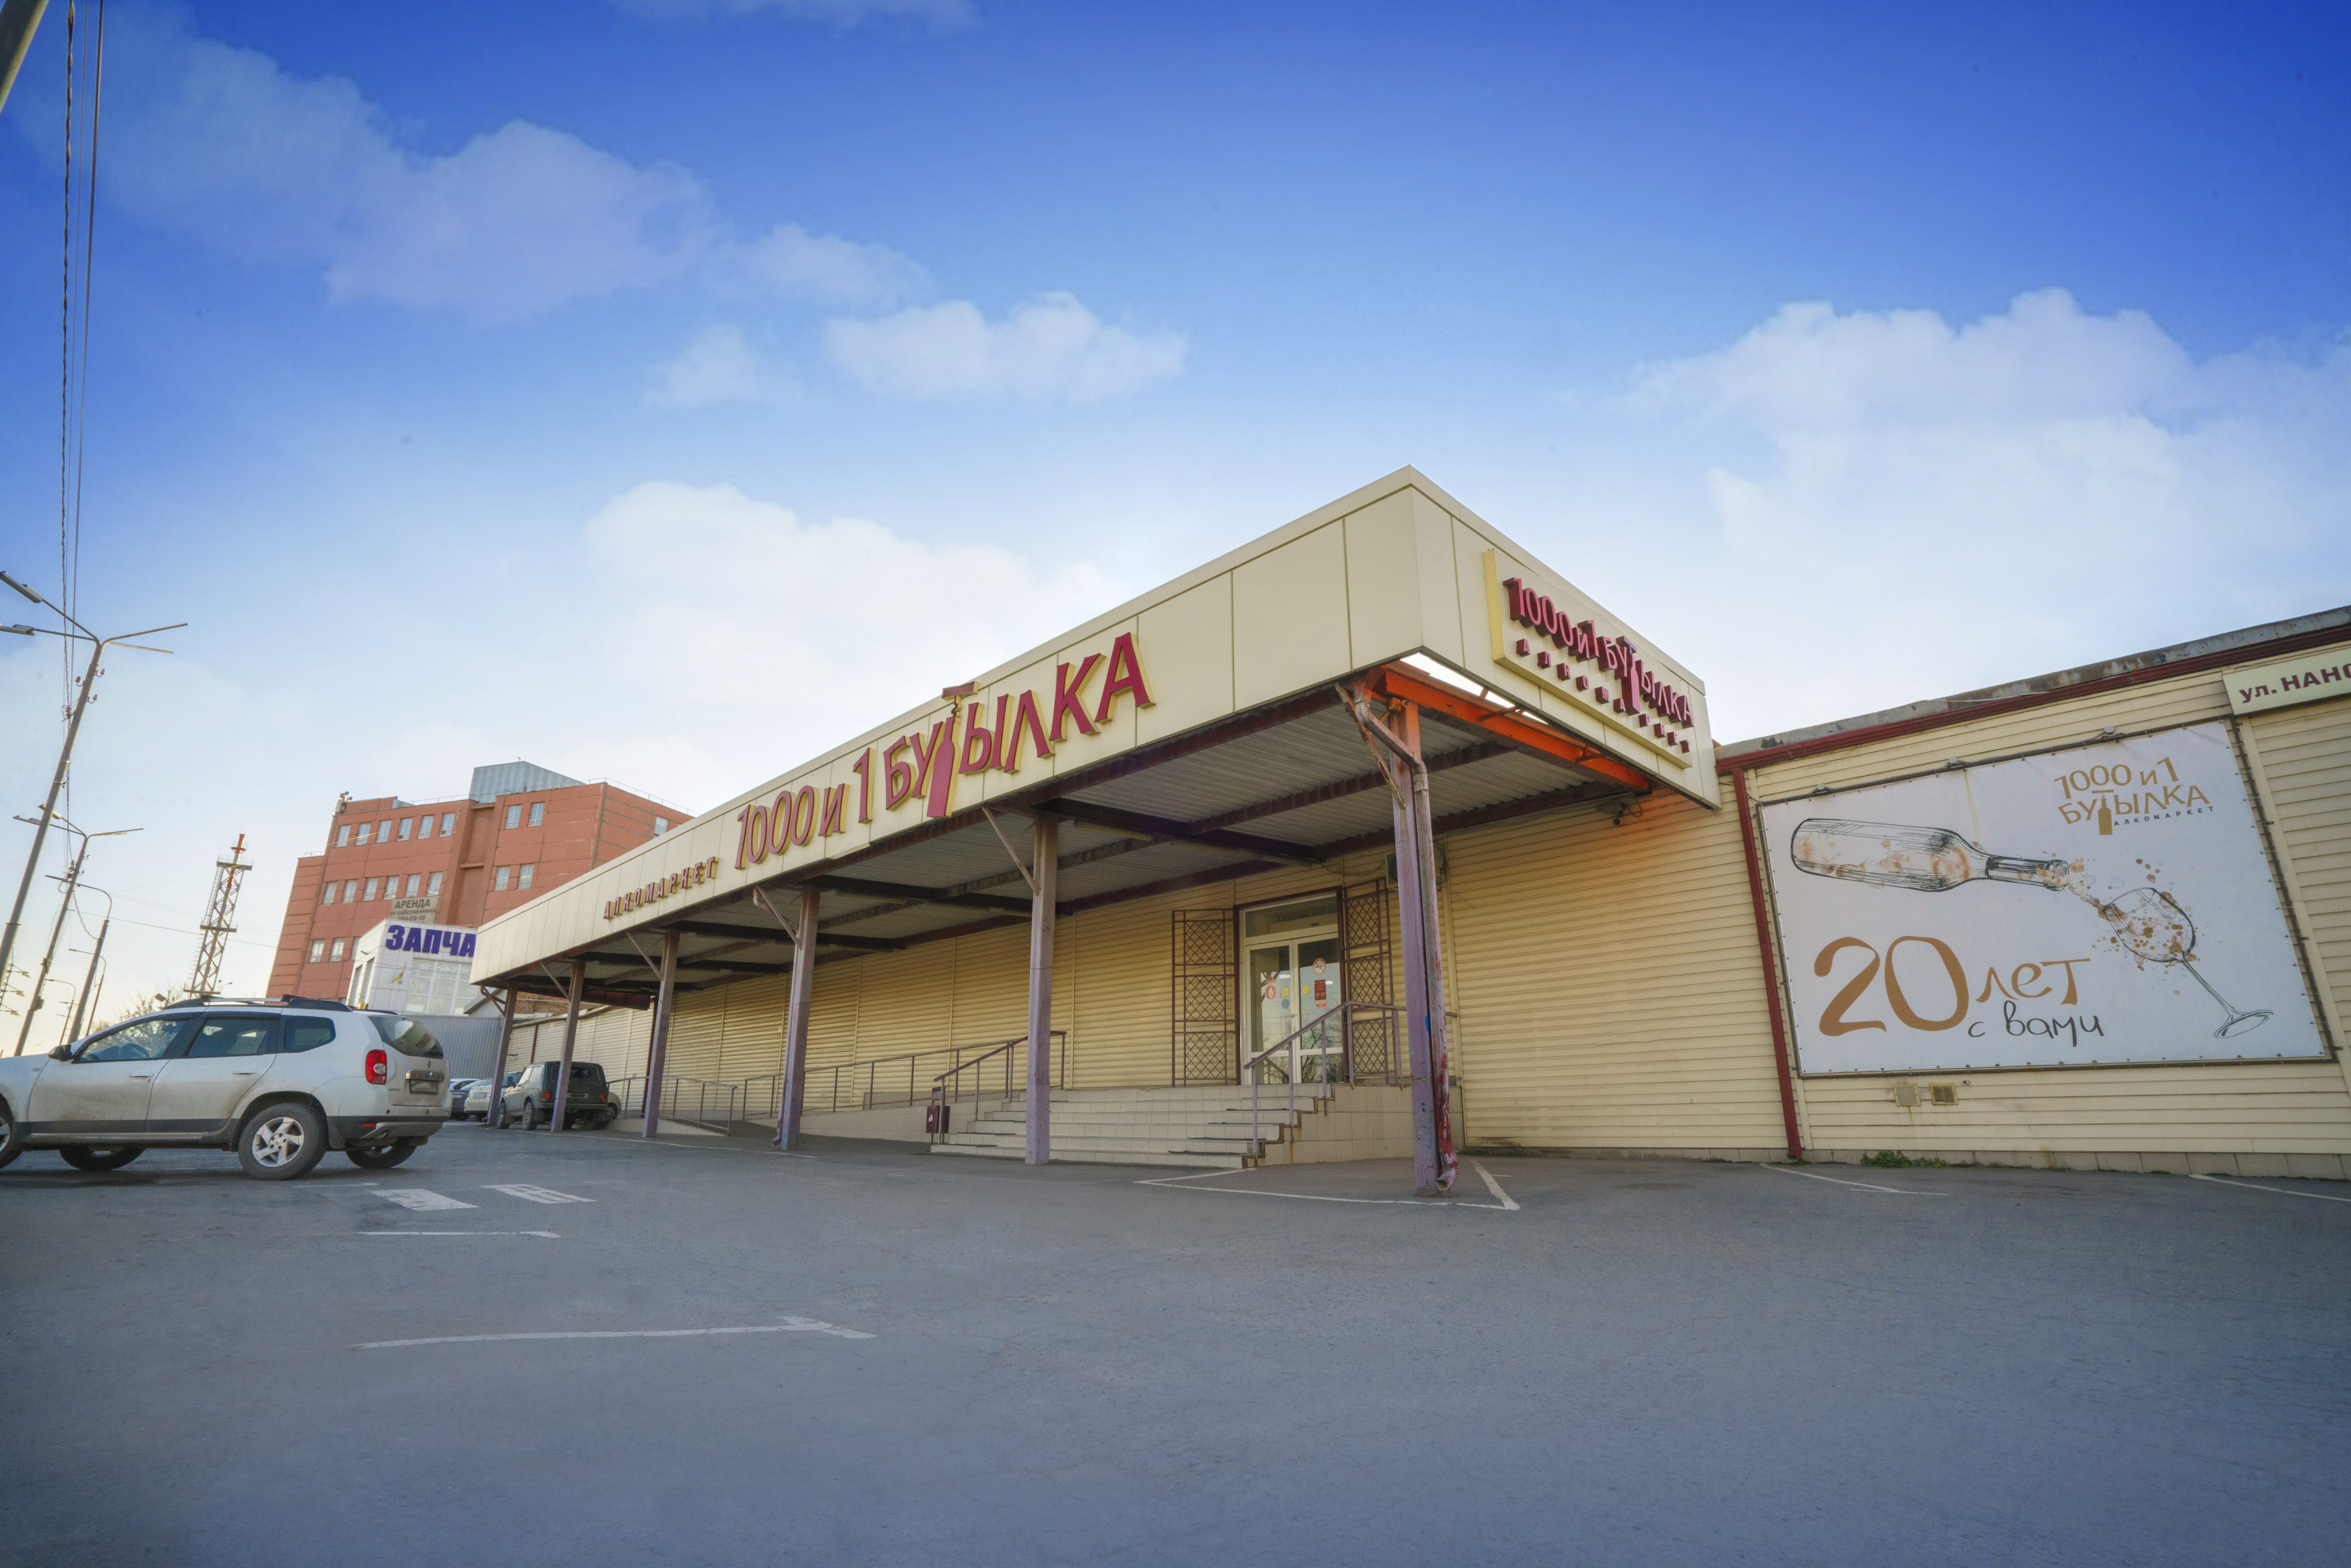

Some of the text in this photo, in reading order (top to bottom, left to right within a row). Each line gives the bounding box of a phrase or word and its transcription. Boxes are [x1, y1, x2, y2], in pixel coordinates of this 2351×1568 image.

[1503, 577, 1573, 649] 1000
[1516, 639, 1690, 753] АЛКОМАРКЕТ
[1596, 636, 1694, 728] БУТЫЛКА
[2239, 685, 2277, 703] ул.
[603, 856, 719, 919] АЛКОМАРКЕТ
[735, 785, 818, 870] 1000
[853, 747, 876, 824] 1
[883, 632, 1156, 817] БУТЫЛКА
[2054, 756, 2179, 799] 1000 и 1
[2058, 785, 2211, 835] БУТЫЛКА
[2114, 806, 2214, 826] АЛКОМАРКЕТ
[394, 899, 430, 909] АРЕНДА
[386, 924, 477, 957] ЗАПЧА
[1814, 936, 2091, 1037] 20 лет
[1968, 1000, 2104, 1047] с вами
